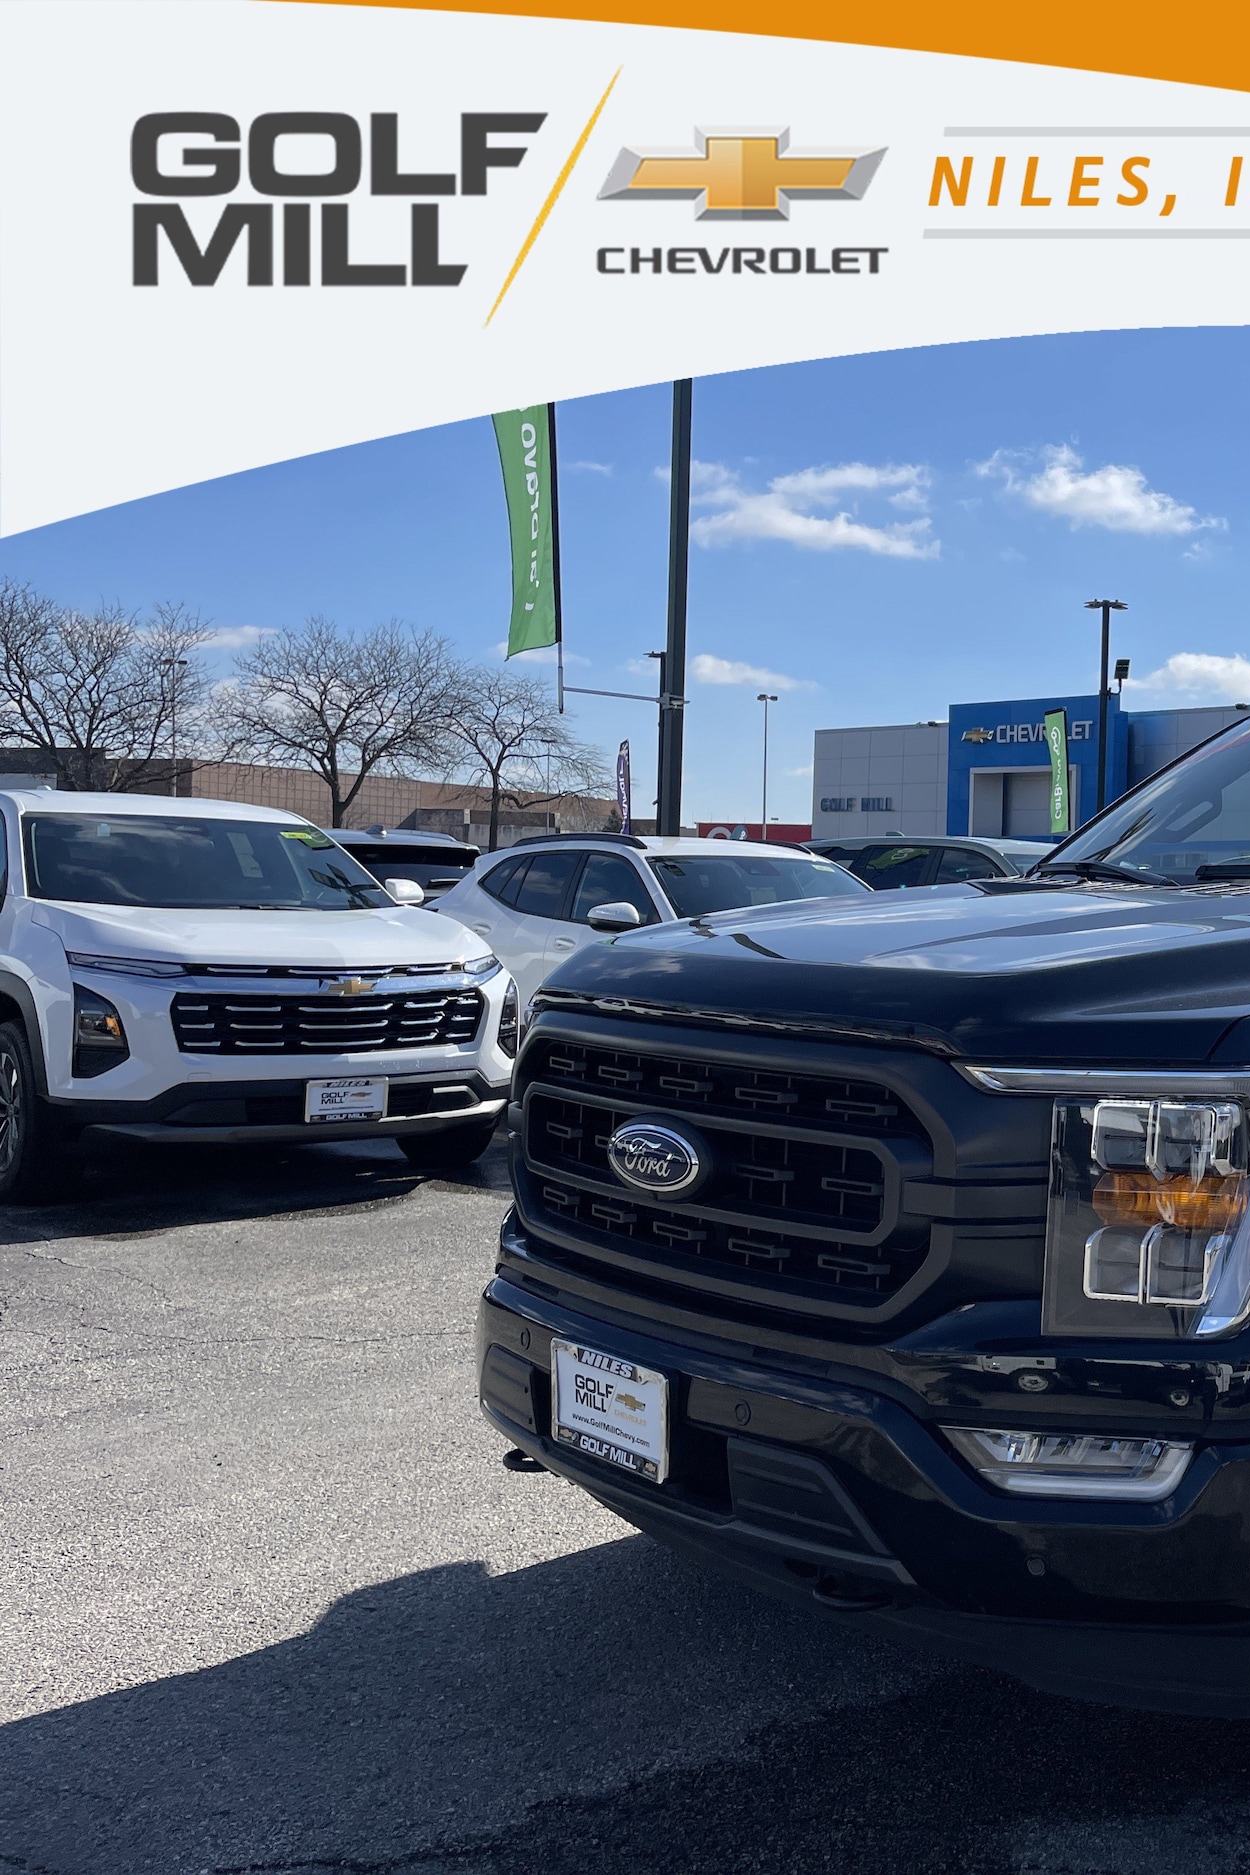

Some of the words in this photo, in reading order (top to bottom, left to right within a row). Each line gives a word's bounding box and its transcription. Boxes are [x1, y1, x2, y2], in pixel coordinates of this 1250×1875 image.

[996, 720, 1094, 743] CHEVRET
[861, 797, 895, 812] MILL
[321, 1091, 350, 1099] GOLF
[581, 1350, 633, 1378] NILES
[575, 1373, 614, 1399] GOLF
[575, 1388, 607, 1413] MILL
[580, 1435, 611, 1457] GOLF
[609, 1446, 637, 1470] MILL
